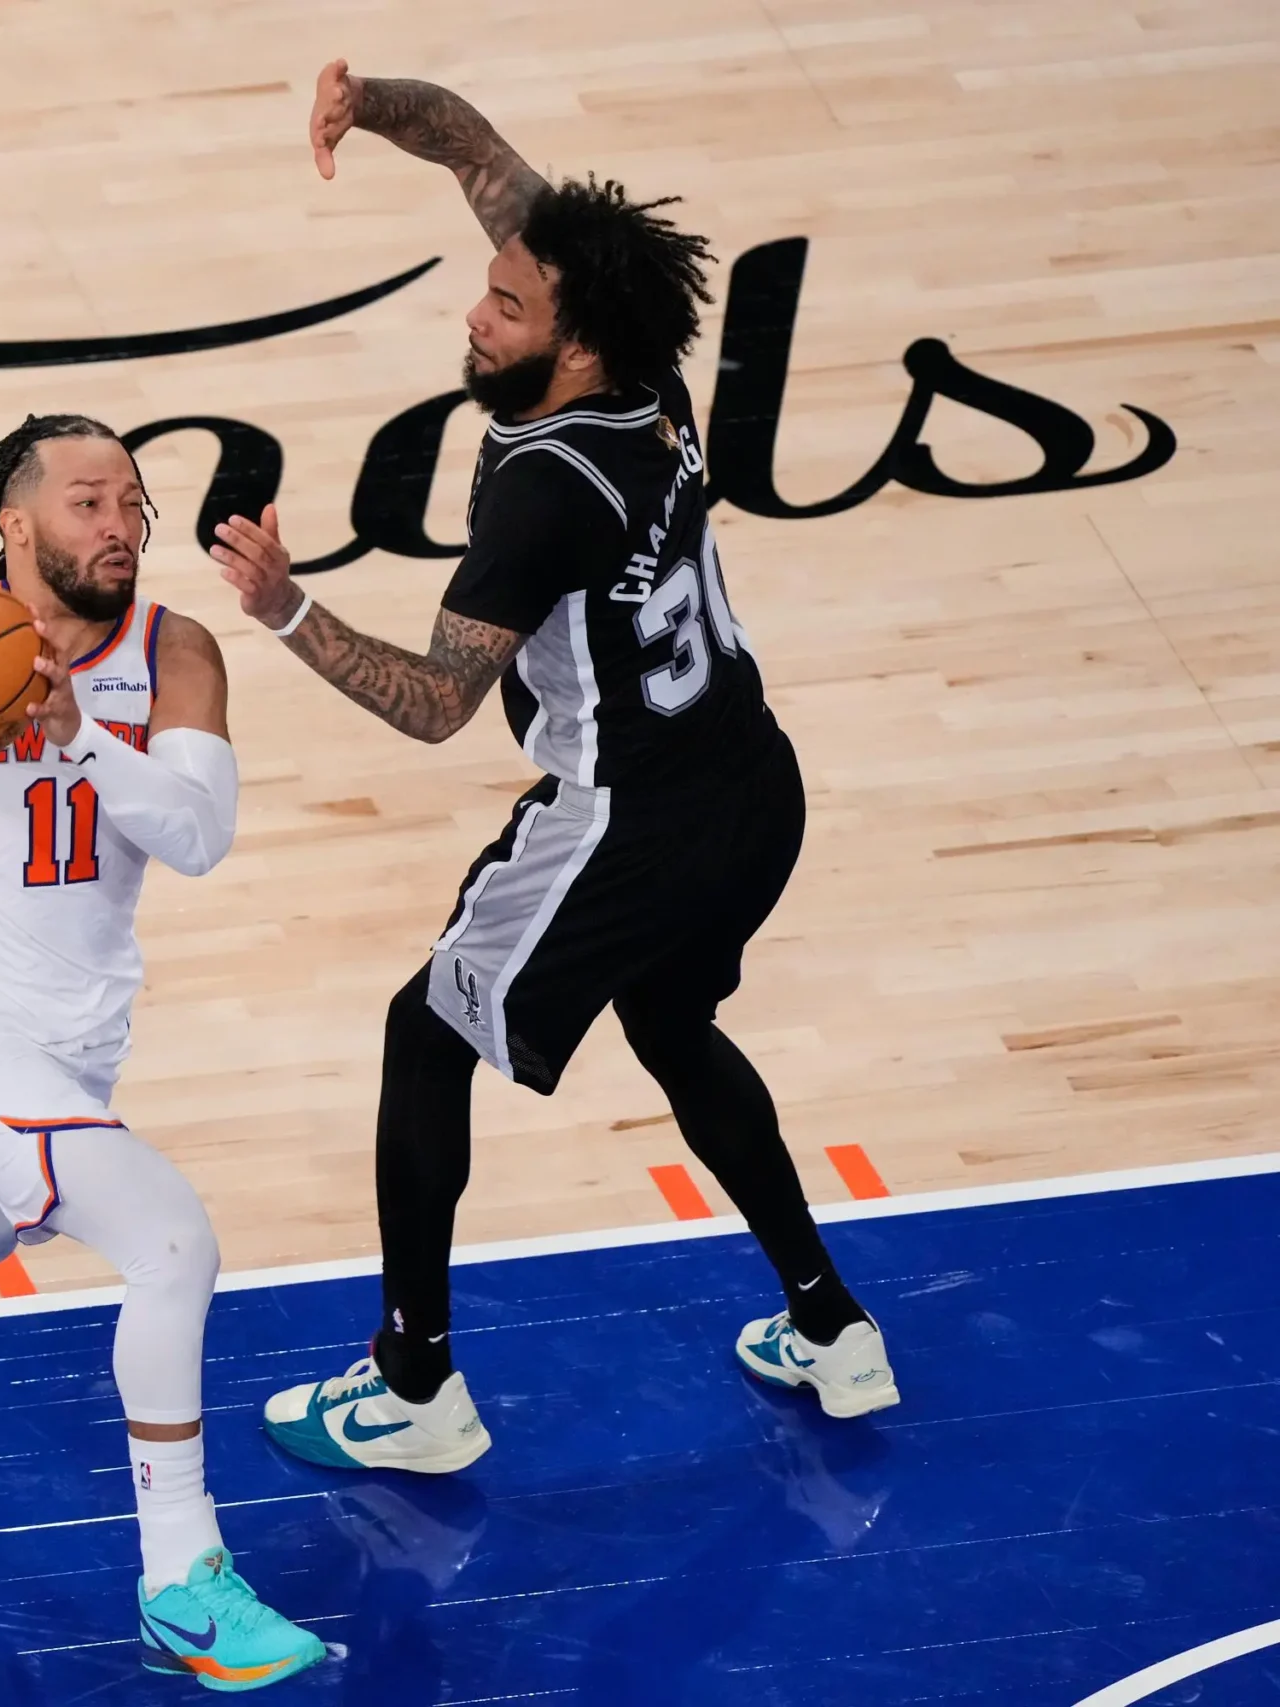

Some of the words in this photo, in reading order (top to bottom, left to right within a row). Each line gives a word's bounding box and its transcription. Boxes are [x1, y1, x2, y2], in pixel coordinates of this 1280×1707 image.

[92, 682, 114, 692] abu
[116, 681, 148, 692] dhabi
[23, 777, 99, 887] 11
